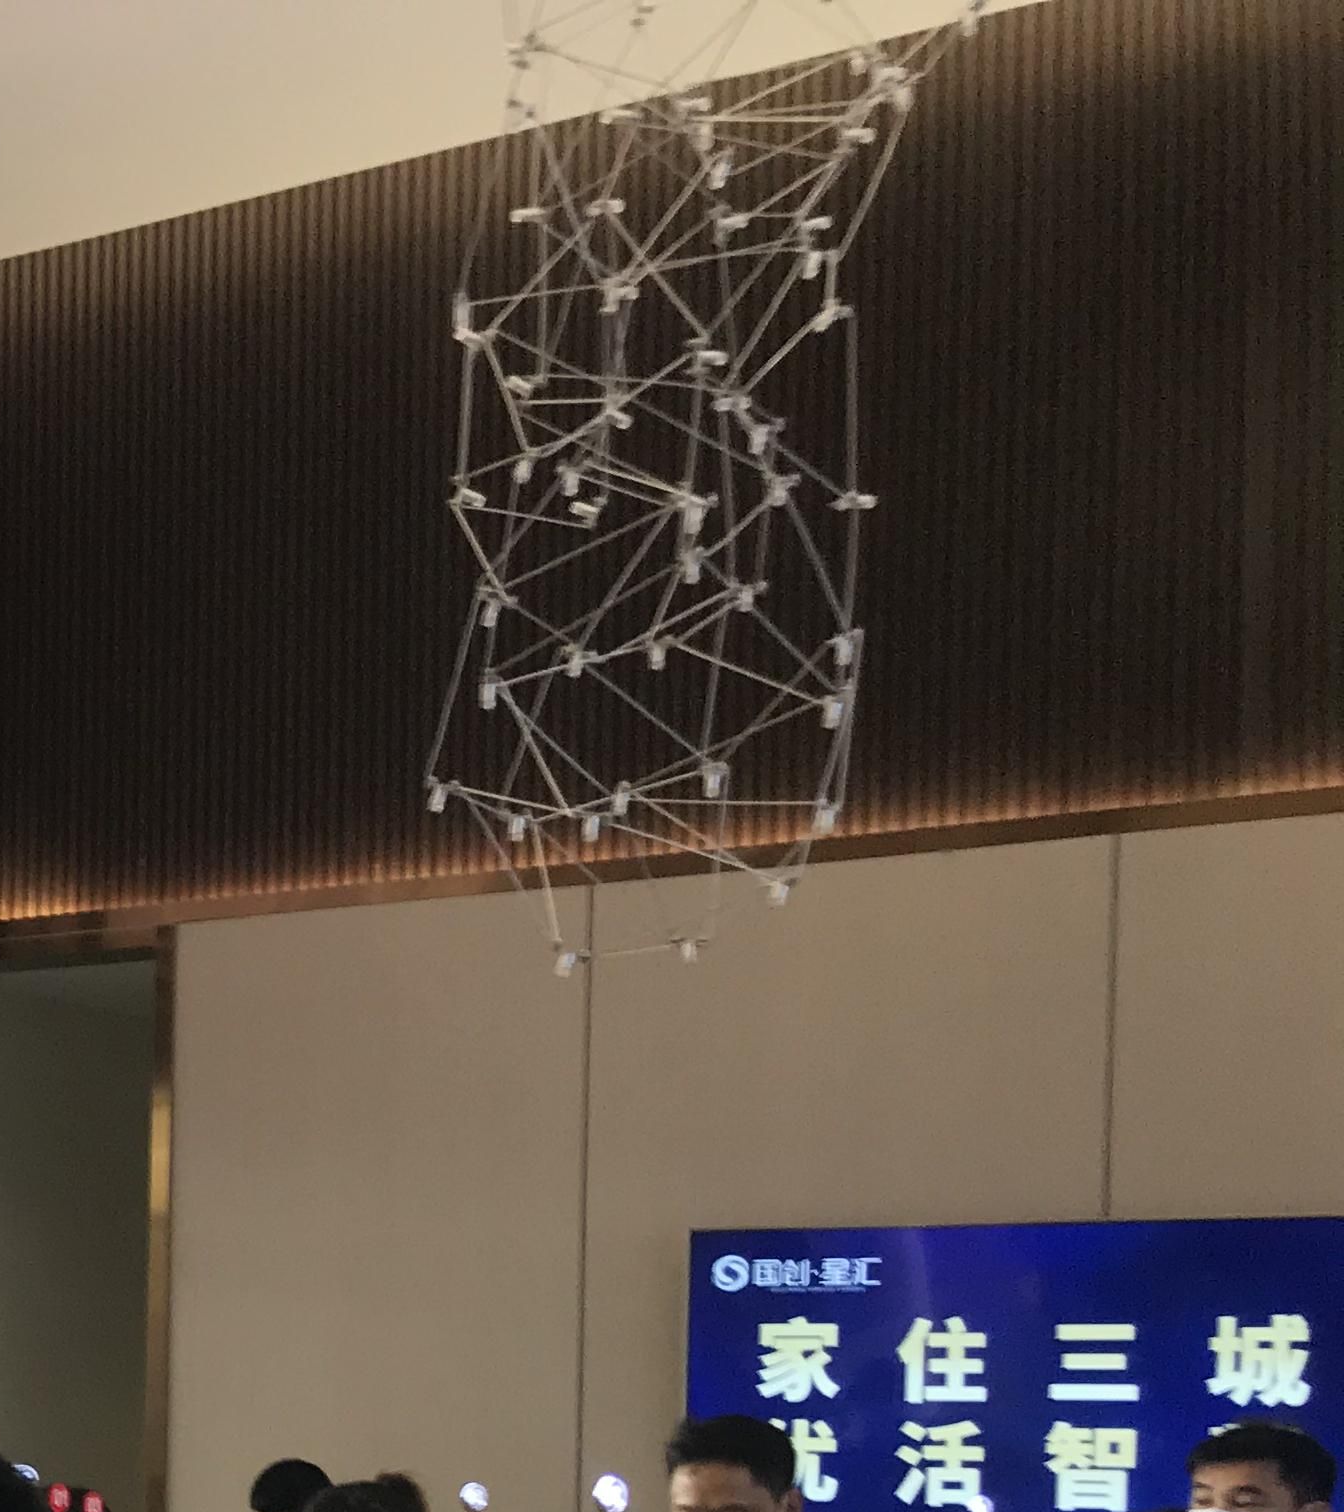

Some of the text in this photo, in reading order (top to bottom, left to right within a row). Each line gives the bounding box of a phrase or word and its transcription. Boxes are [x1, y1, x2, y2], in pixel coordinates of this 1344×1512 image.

[751, 1257, 883, 1287] 国创·星汇
[756, 1314, 1312, 1407] 家住三城
[768, 1417, 1242, 1512] 优活智
